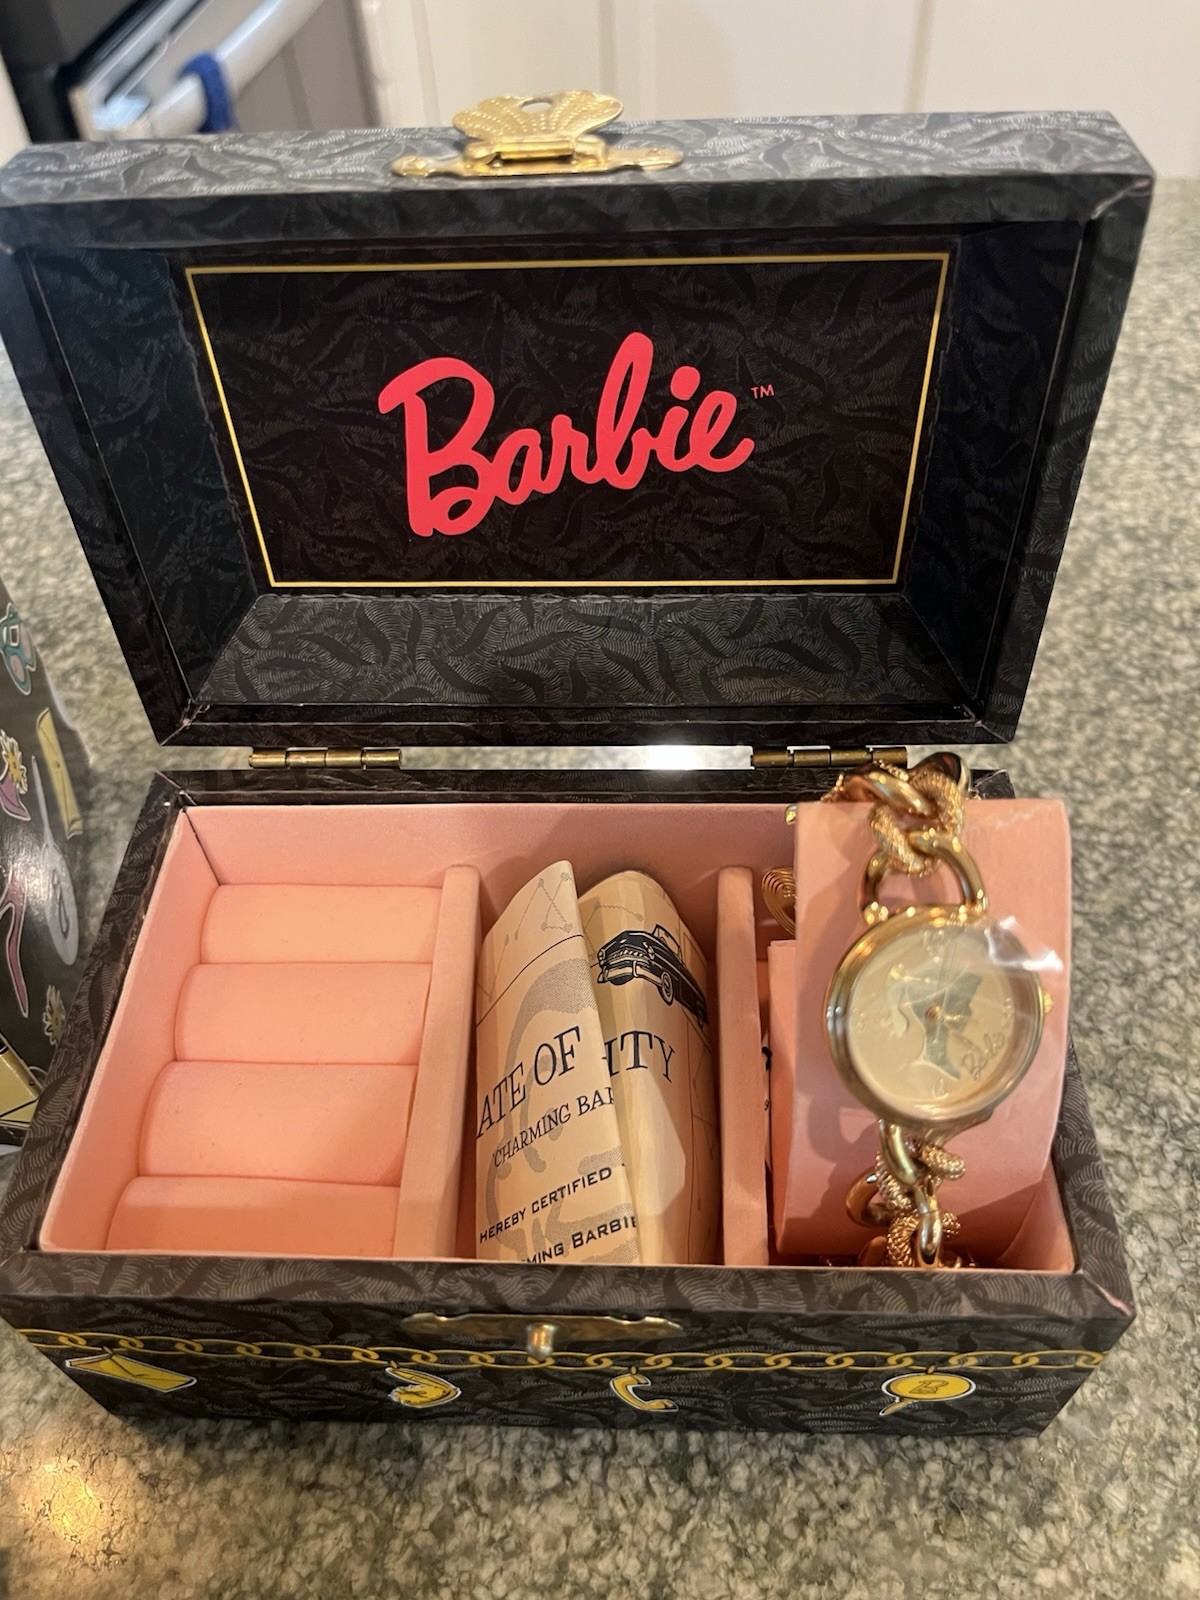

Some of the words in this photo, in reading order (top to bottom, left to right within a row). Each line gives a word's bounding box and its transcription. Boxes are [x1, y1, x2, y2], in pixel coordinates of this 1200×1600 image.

[378, 332, 755, 537] Barbie
[533, 1026, 581, 1086] OF
[479, 1206, 527, 1243] HEREBY
[531, 1166, 613, 1214] CERTIFIED
[521, 1242, 565, 1263] MING
